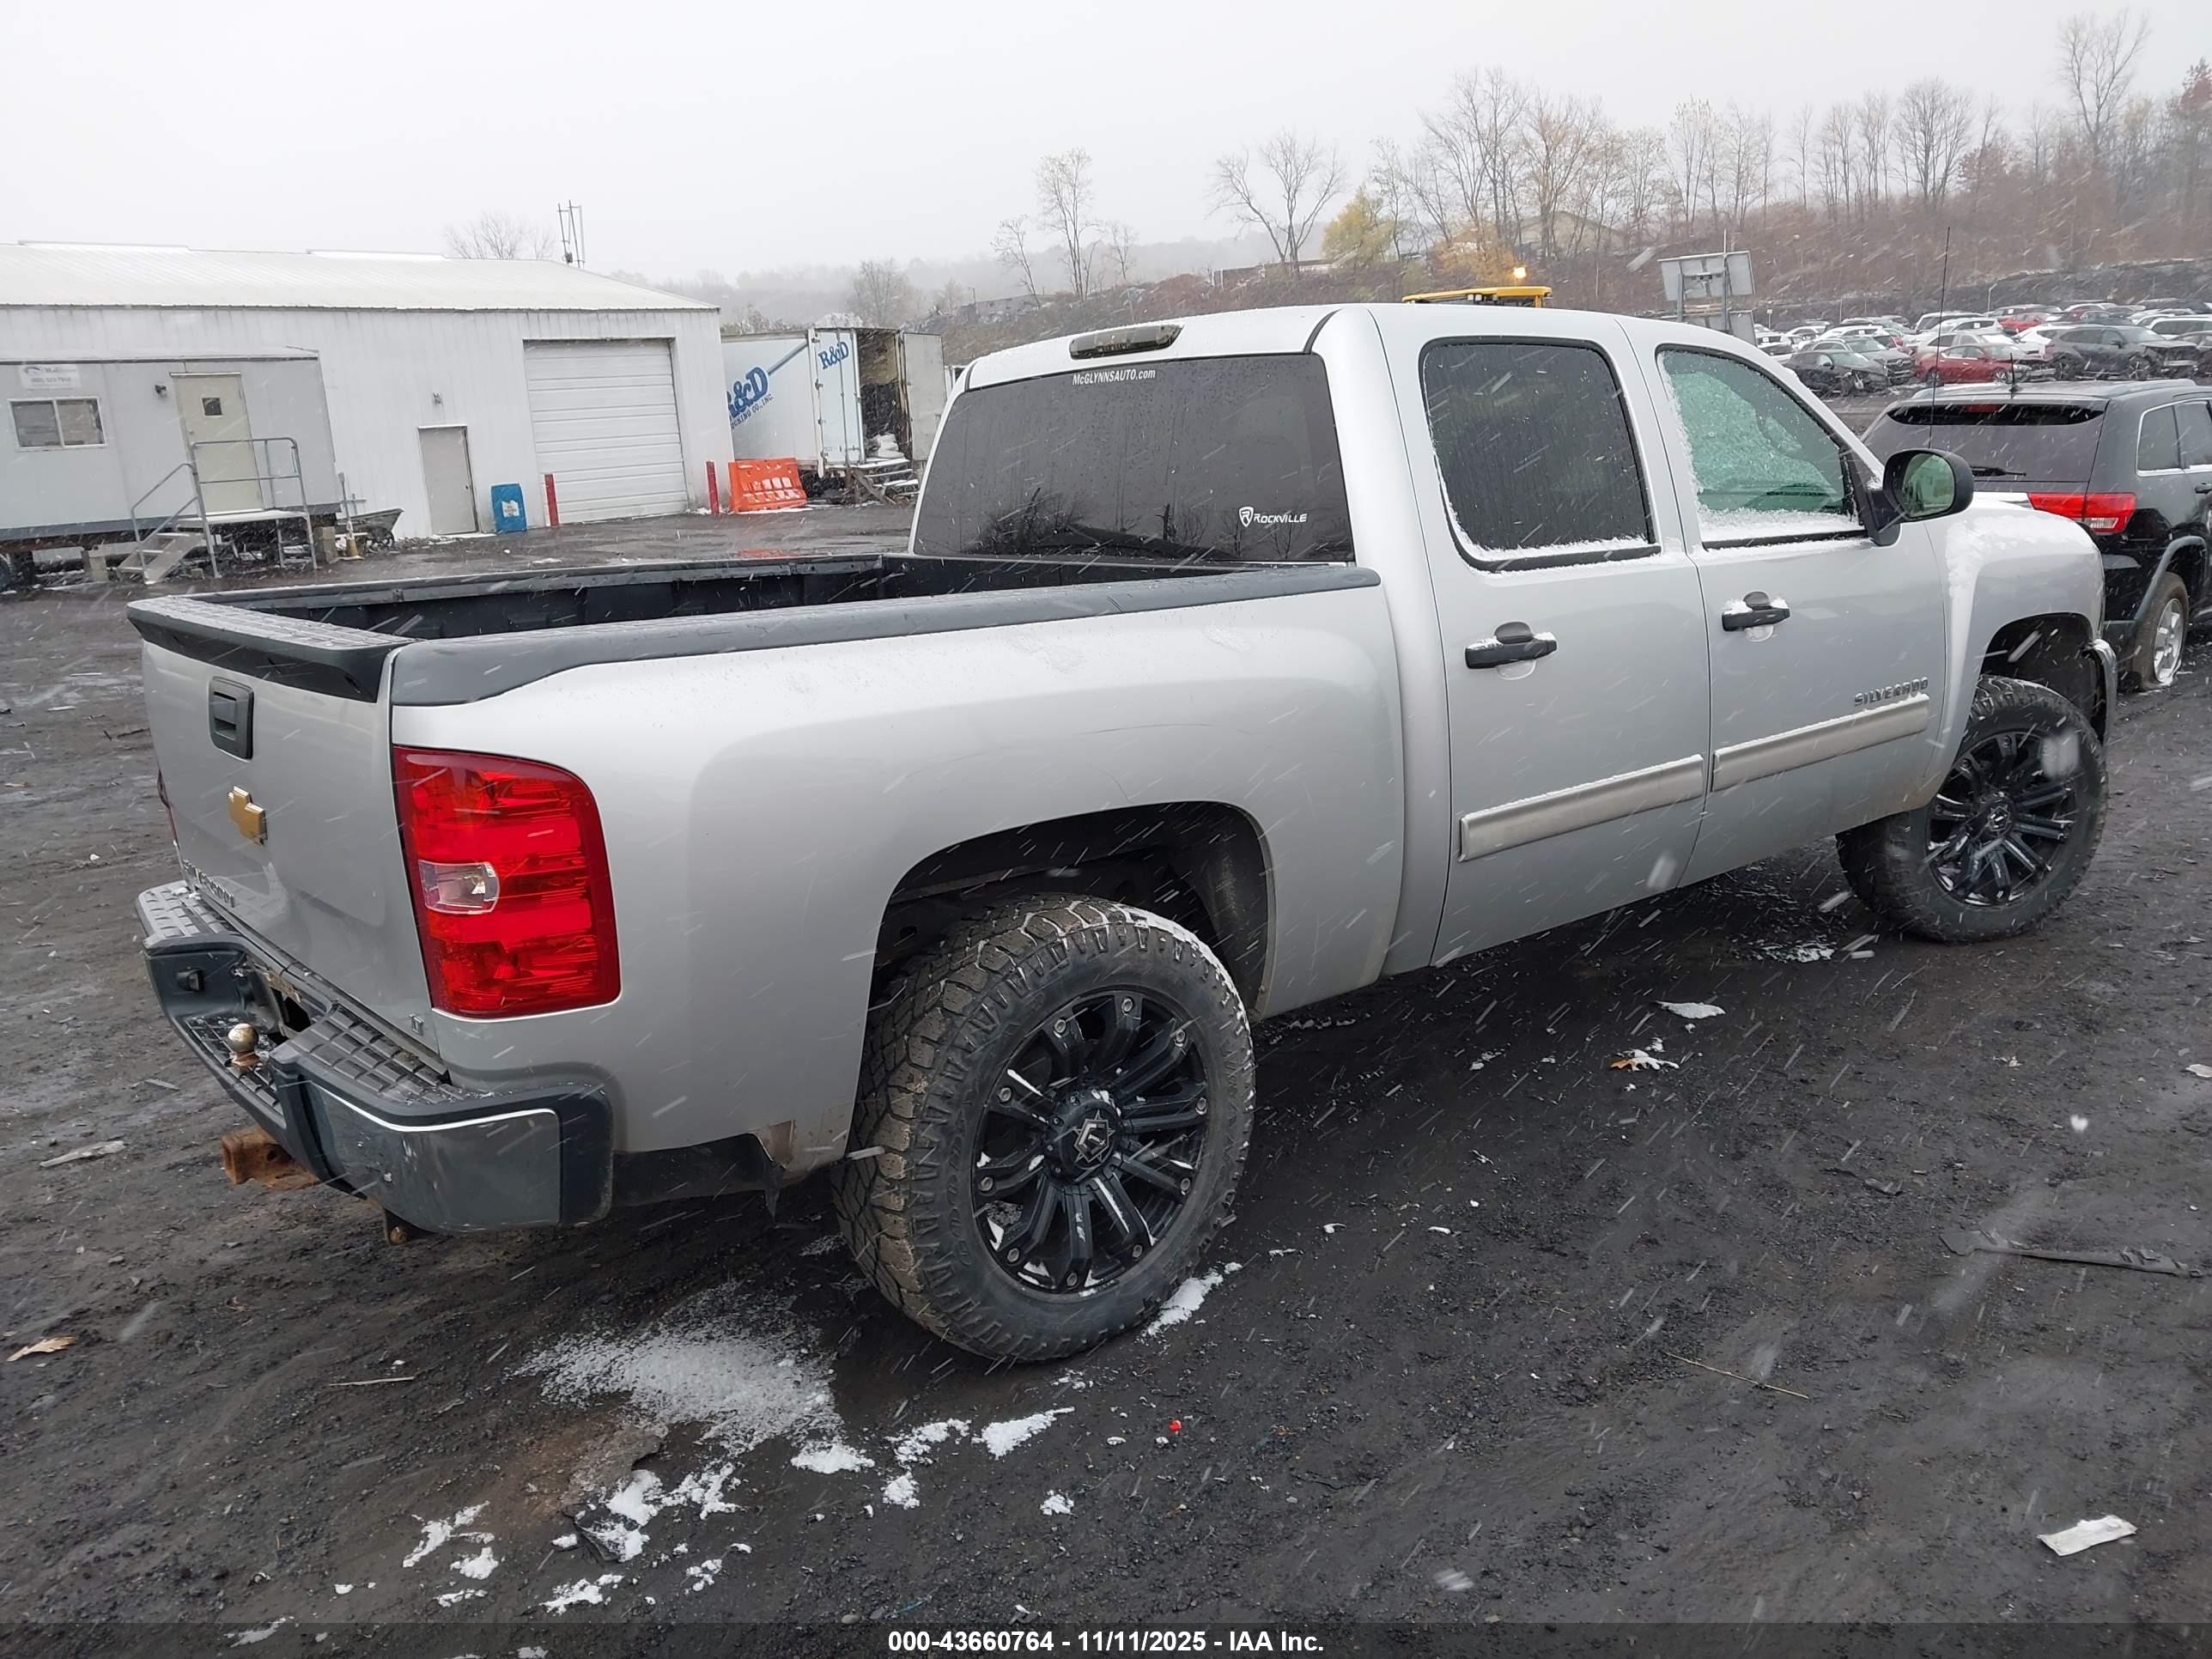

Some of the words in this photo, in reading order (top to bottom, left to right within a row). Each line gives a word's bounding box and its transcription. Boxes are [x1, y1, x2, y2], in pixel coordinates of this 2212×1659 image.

[817, 342, 849, 370] R&D
[1072, 368, 1157, 386] McGLYNNSAUTO.com
[1253, 513, 1308, 524] ROCKVILLE
[1855, 676, 1929, 707] SILVERADO
